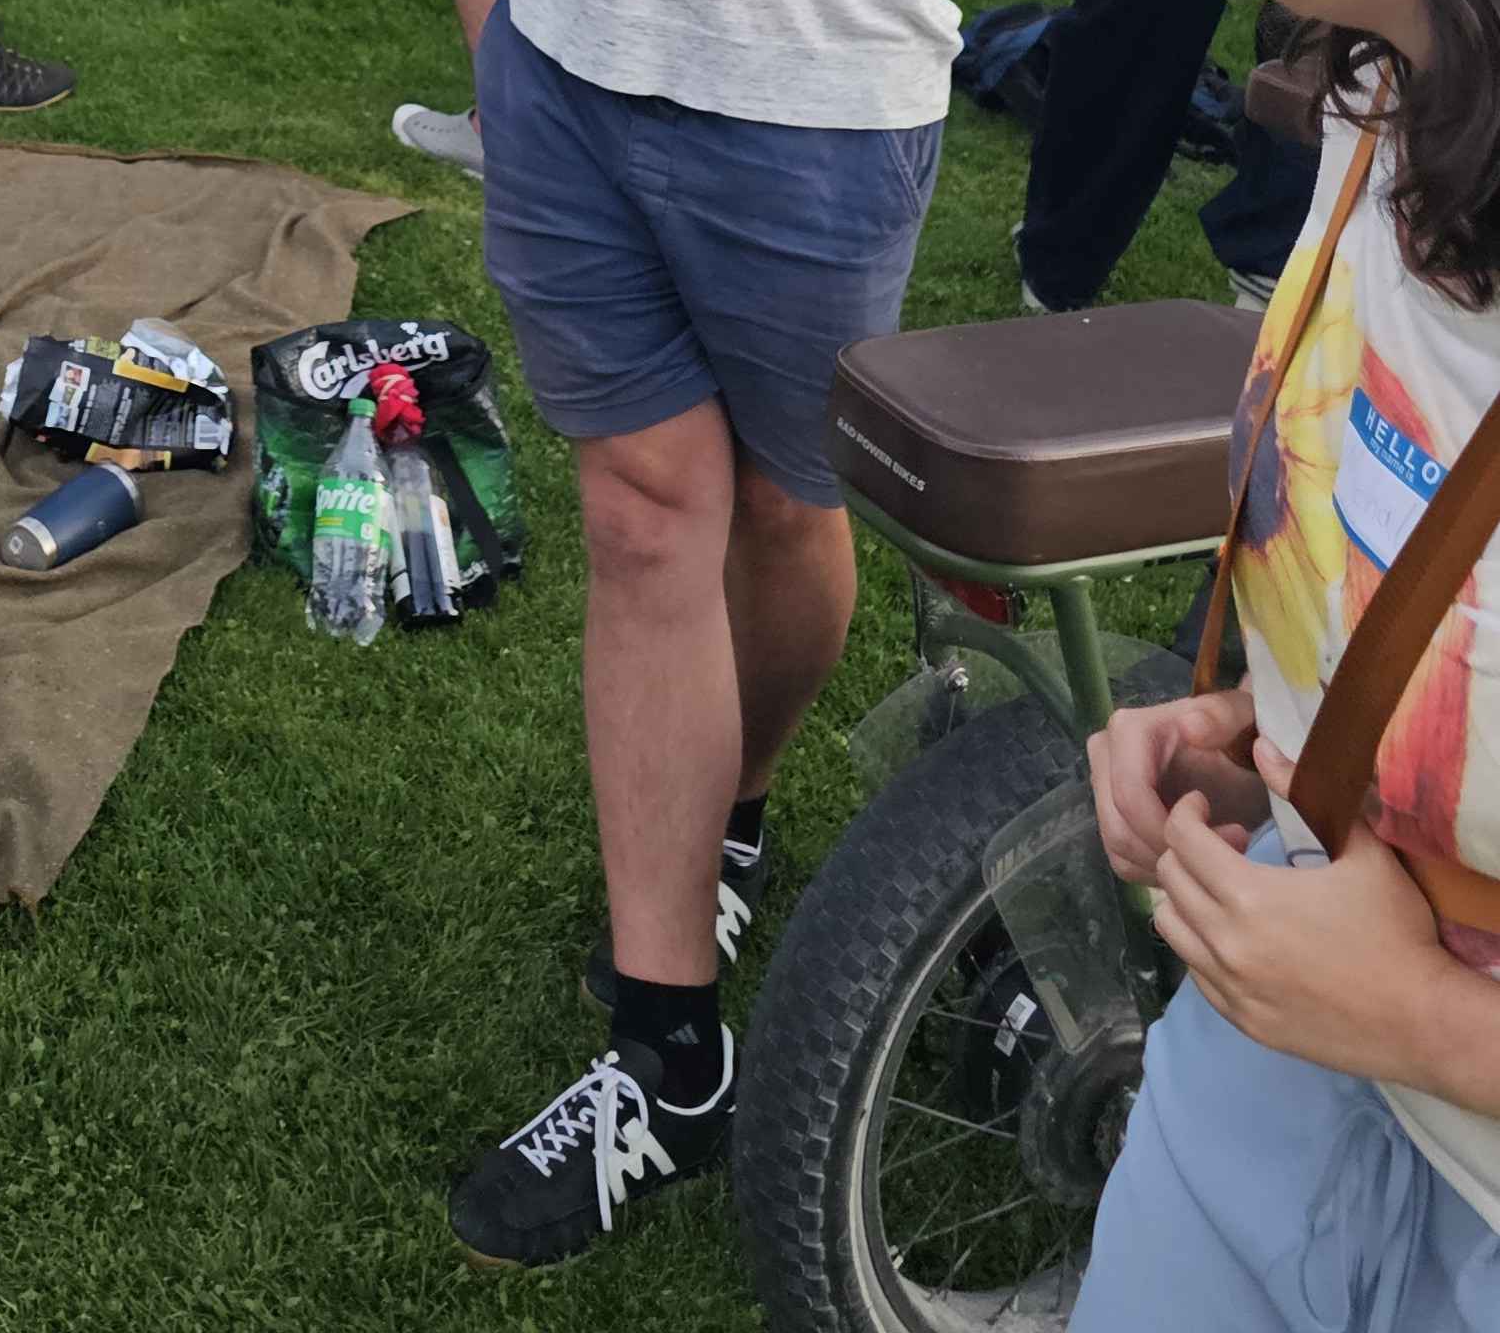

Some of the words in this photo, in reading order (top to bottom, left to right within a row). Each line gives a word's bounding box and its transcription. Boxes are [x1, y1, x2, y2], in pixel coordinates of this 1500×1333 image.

[298, 330, 450, 400] Carlsberg
[856, 433, 892, 468] POWER
[892, 461, 926, 492] BIKES
[1365, 406, 1440, 484] HELLO
